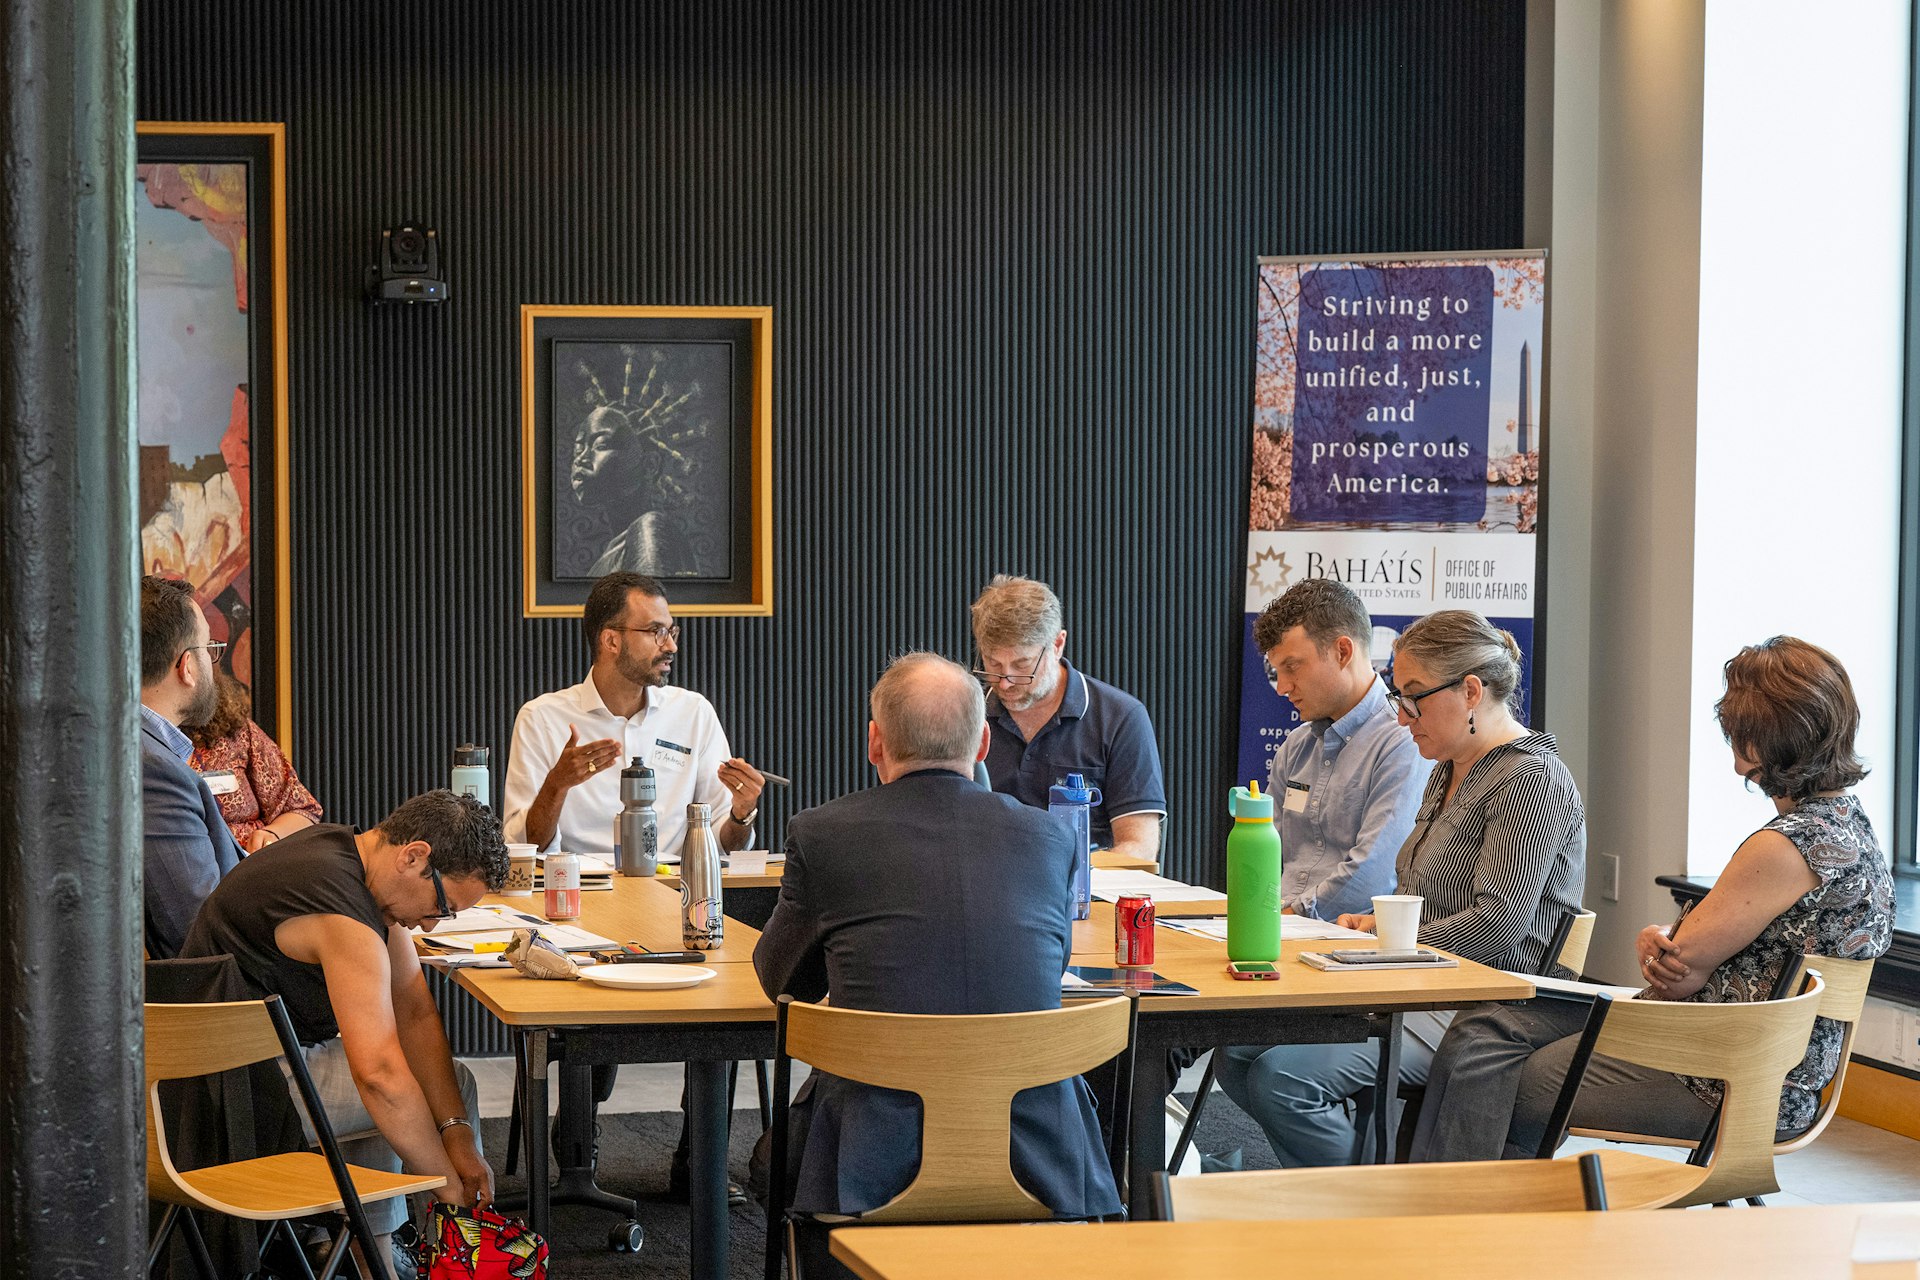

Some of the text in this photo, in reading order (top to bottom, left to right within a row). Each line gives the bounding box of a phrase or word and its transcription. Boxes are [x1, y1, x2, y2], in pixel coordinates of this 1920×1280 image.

[1323, 295, 1469, 321] Striving to
[1308, 328, 1482, 352] build a more
[1305, 363, 1481, 393] unified, just,
[1366, 399, 1415, 422] and
[1311, 441, 1469, 465] prosperous
[1326, 472, 1449, 494] America.
[1445, 559, 1496, 578] OFFICE OF
[1444, 581, 1528, 601] PUBLIC AFFAIRS
